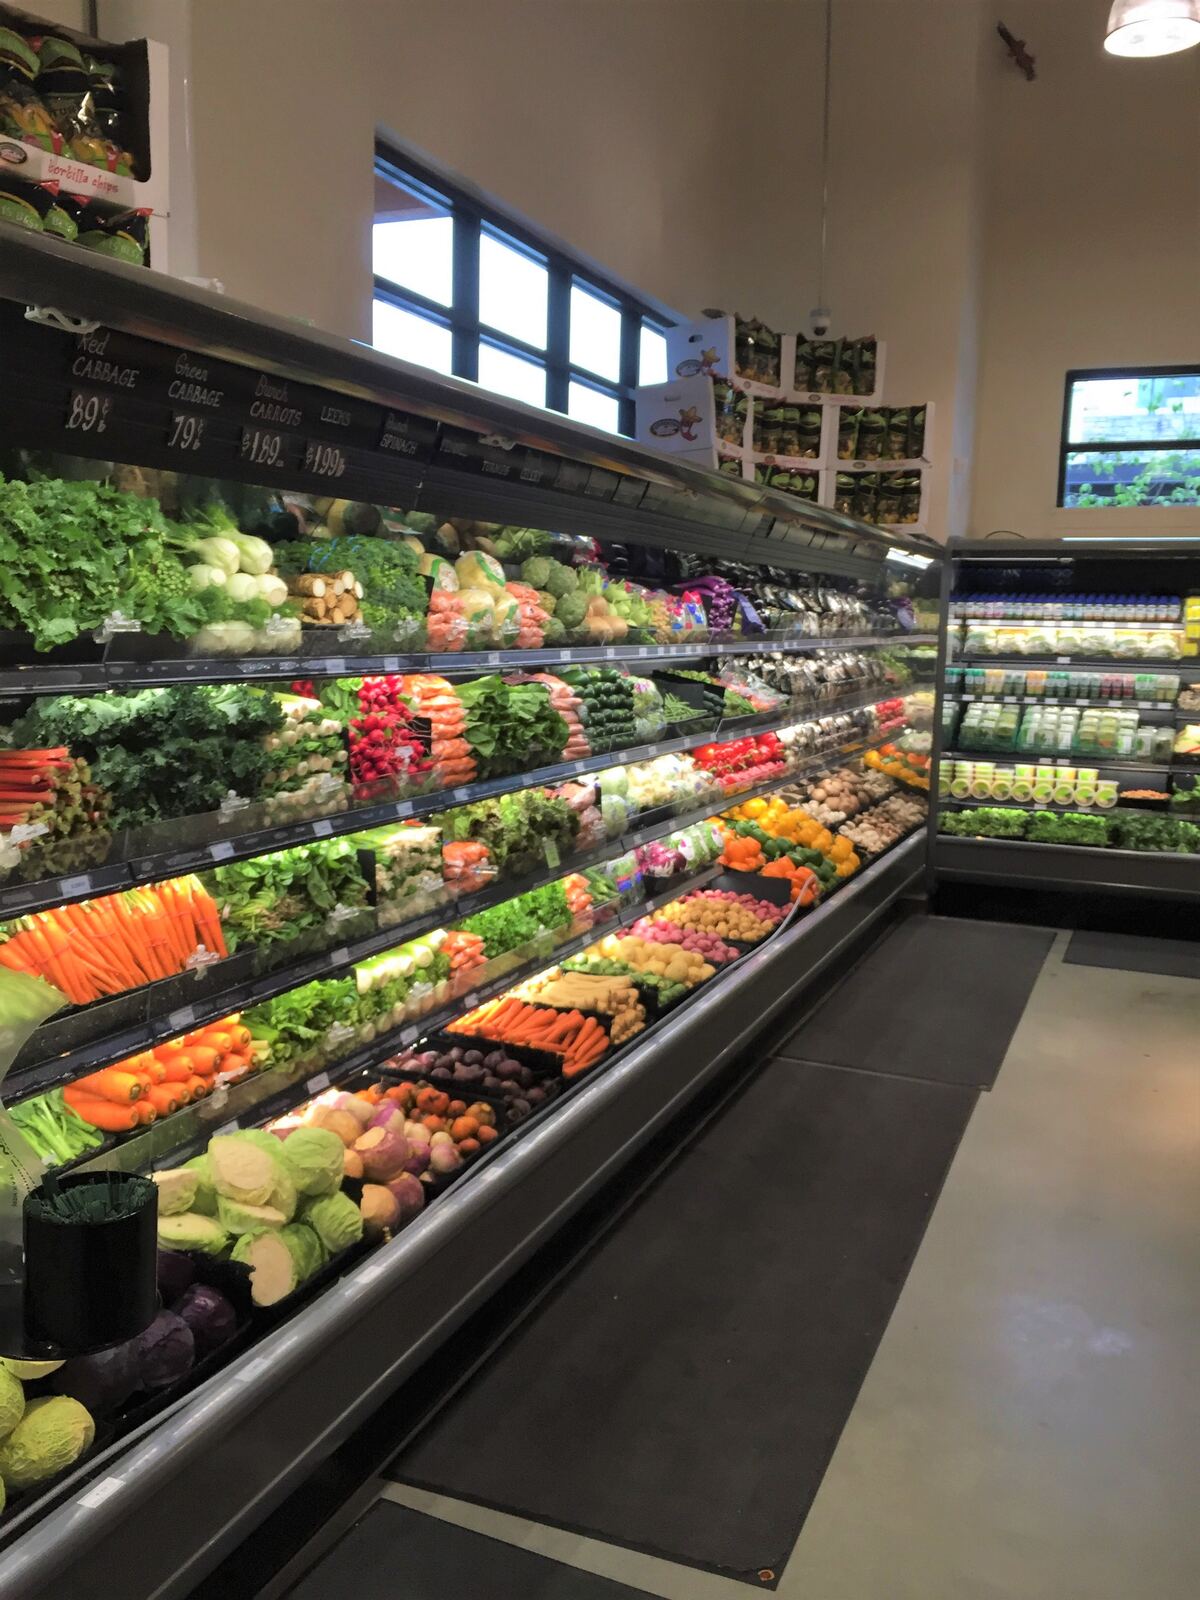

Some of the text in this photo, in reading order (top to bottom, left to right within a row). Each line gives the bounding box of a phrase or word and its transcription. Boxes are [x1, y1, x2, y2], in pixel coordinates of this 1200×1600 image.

[77, 333, 110, 355] Red
[72, 356, 140, 389] CABBAGE
[175, 353, 209, 382] Green
[168, 380, 224, 407] CABBAGE
[249, 400, 303, 426] CARROTS
